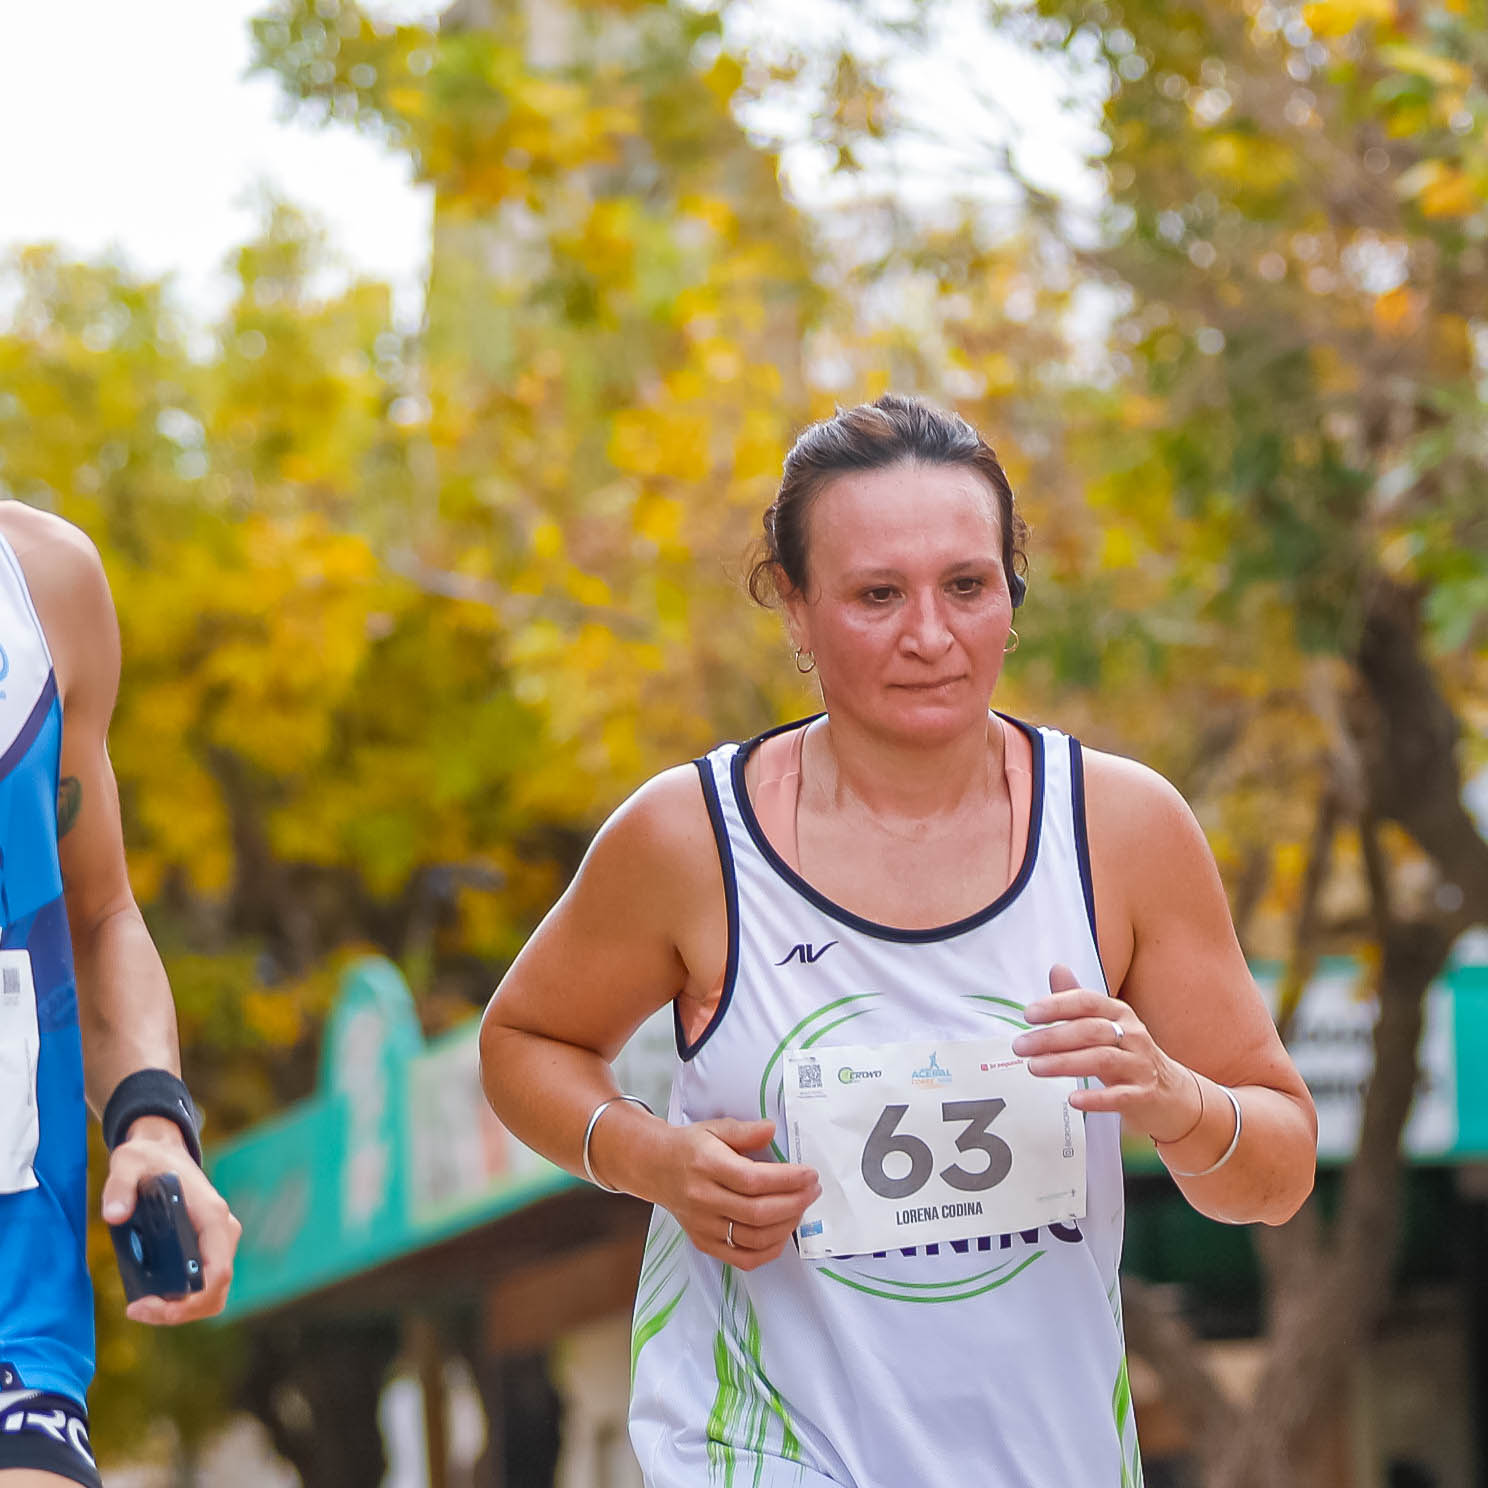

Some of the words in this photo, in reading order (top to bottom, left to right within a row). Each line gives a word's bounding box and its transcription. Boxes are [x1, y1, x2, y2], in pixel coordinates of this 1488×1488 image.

[861, 1097, 1012, 1199] 63
[896, 1206, 939, 1225] LORENA
[941, 1201, 983, 1219] CODINA
